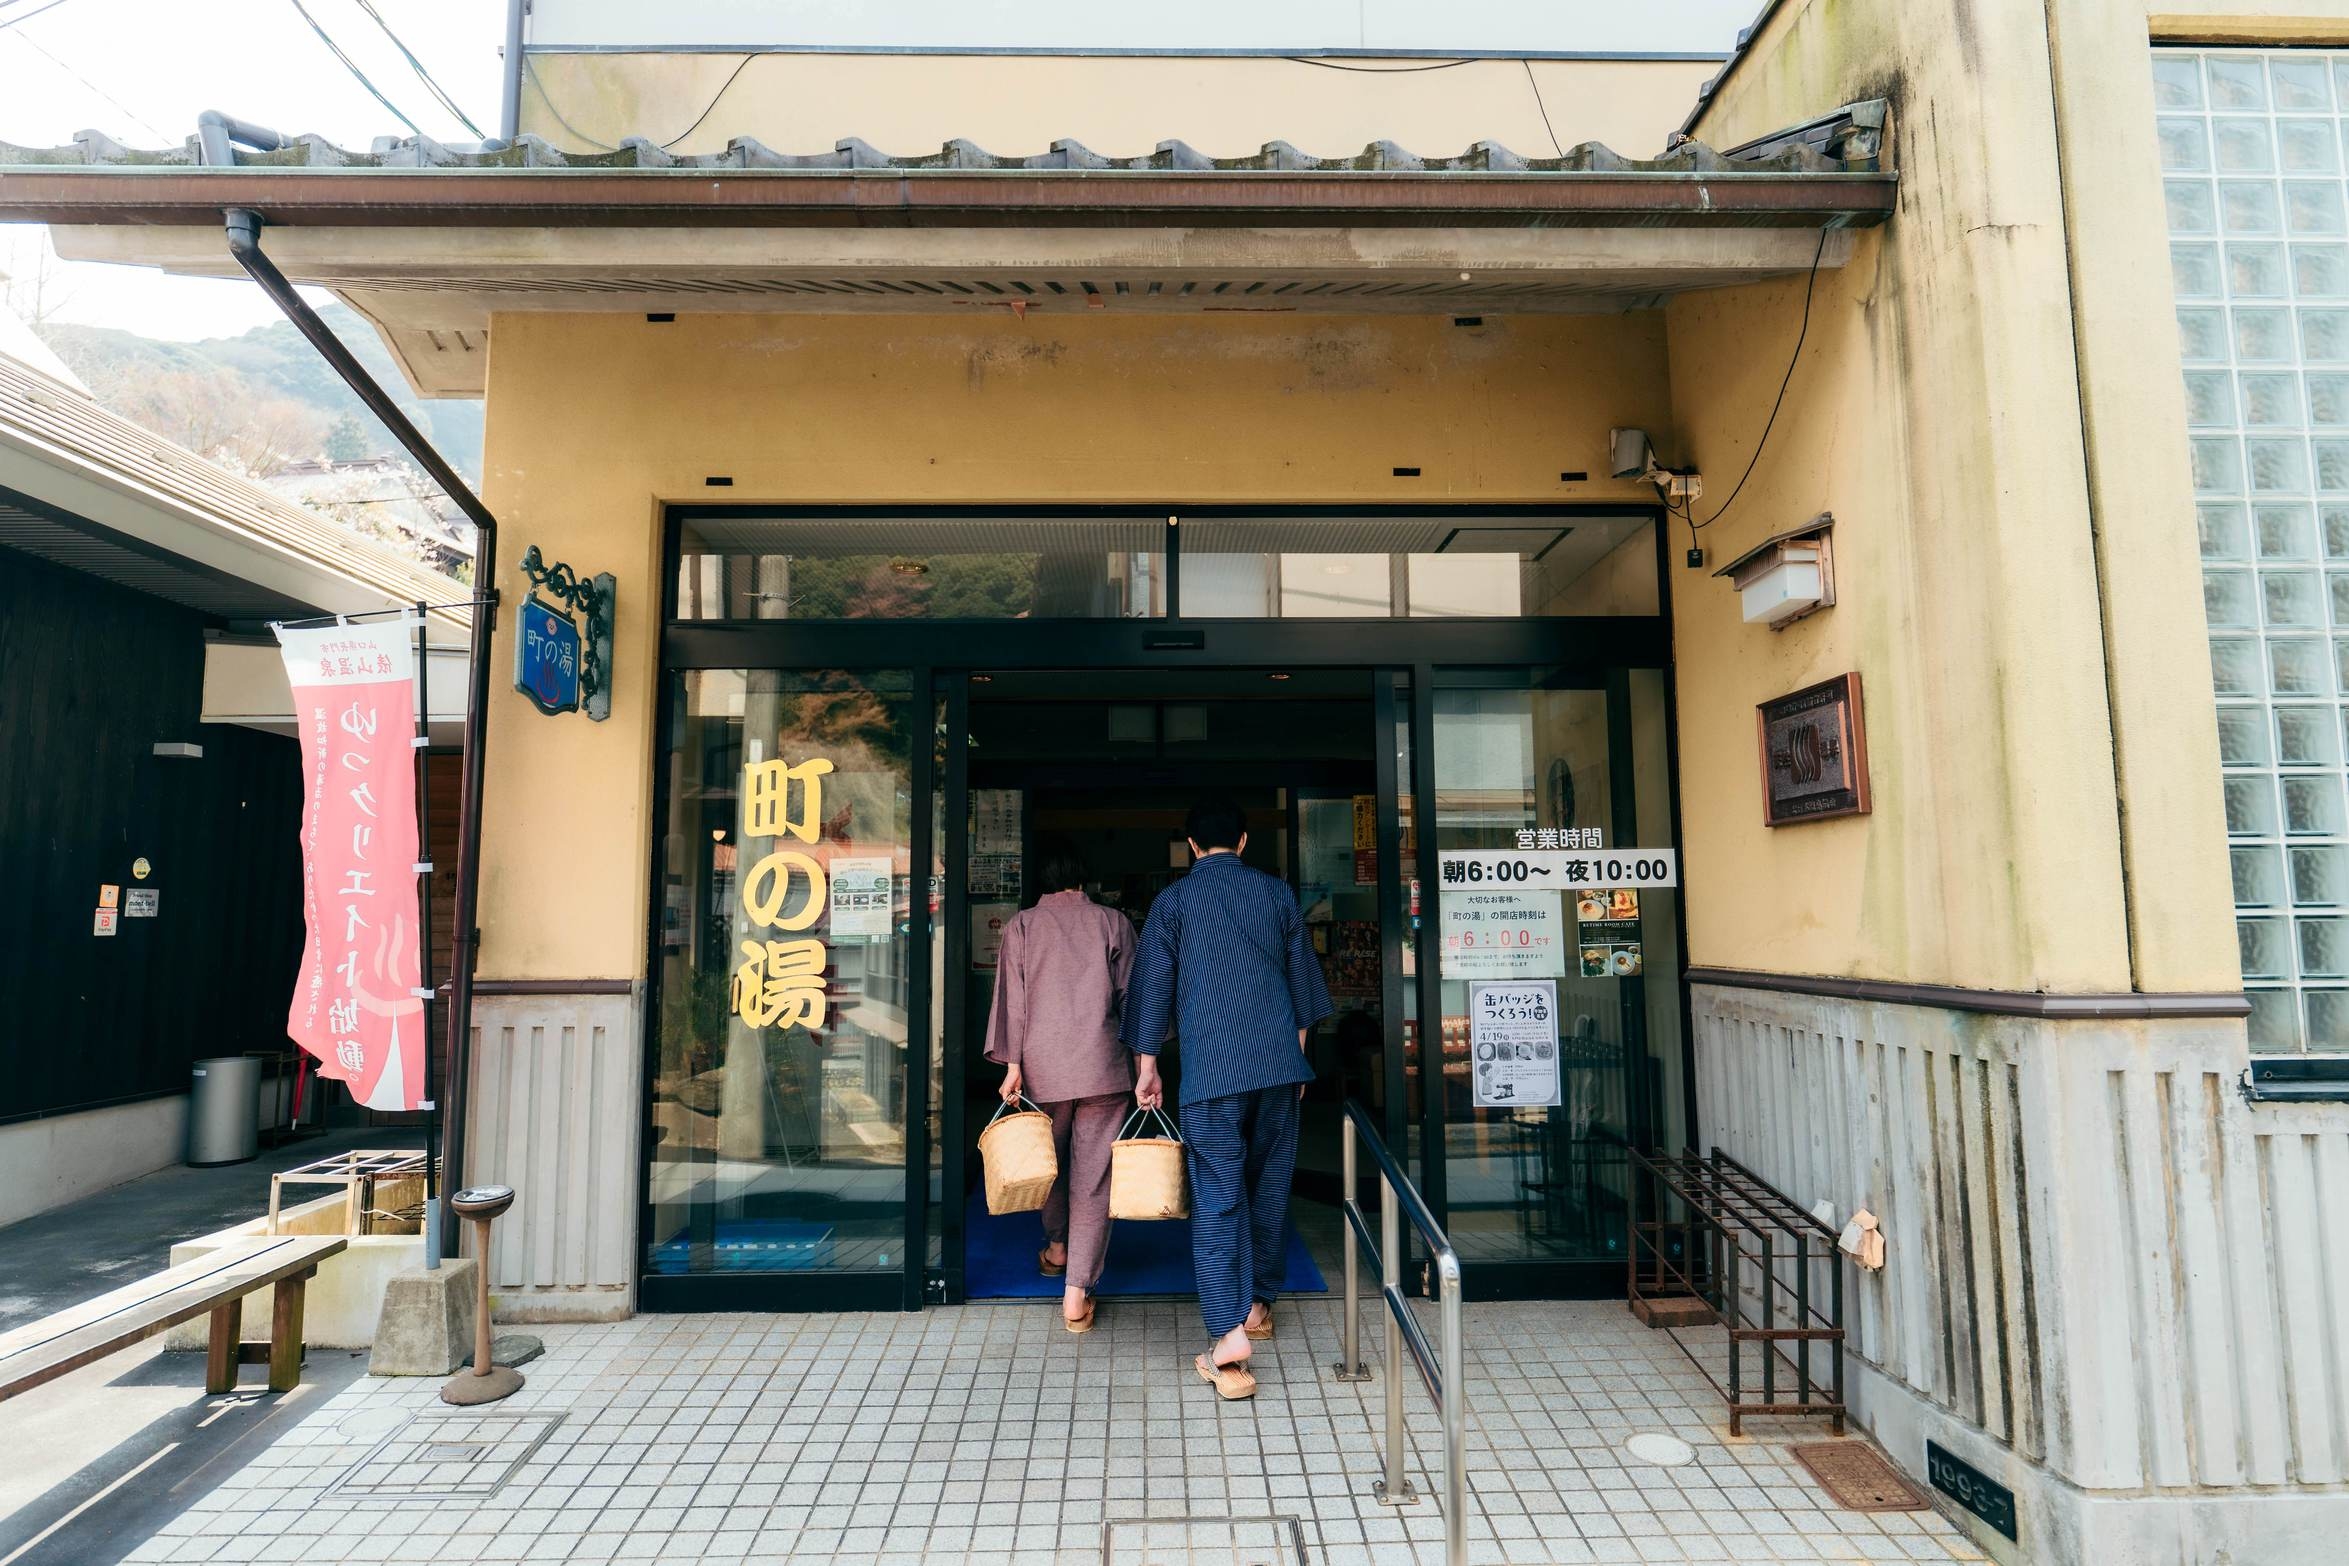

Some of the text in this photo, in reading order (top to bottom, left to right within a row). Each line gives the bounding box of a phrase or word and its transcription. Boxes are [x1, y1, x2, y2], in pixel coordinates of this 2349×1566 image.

[527, 629, 573, 678] 町の湯
[1514, 827, 1604, 850] 営業時間
[1565, 858, 1668, 884] 夜10:00
[737, 757, 834, 1030] 町の湯
[1467, 895, 1521, 905] 大切なお客様へ
[1484, 993, 1544, 1008] 缶バッジを
